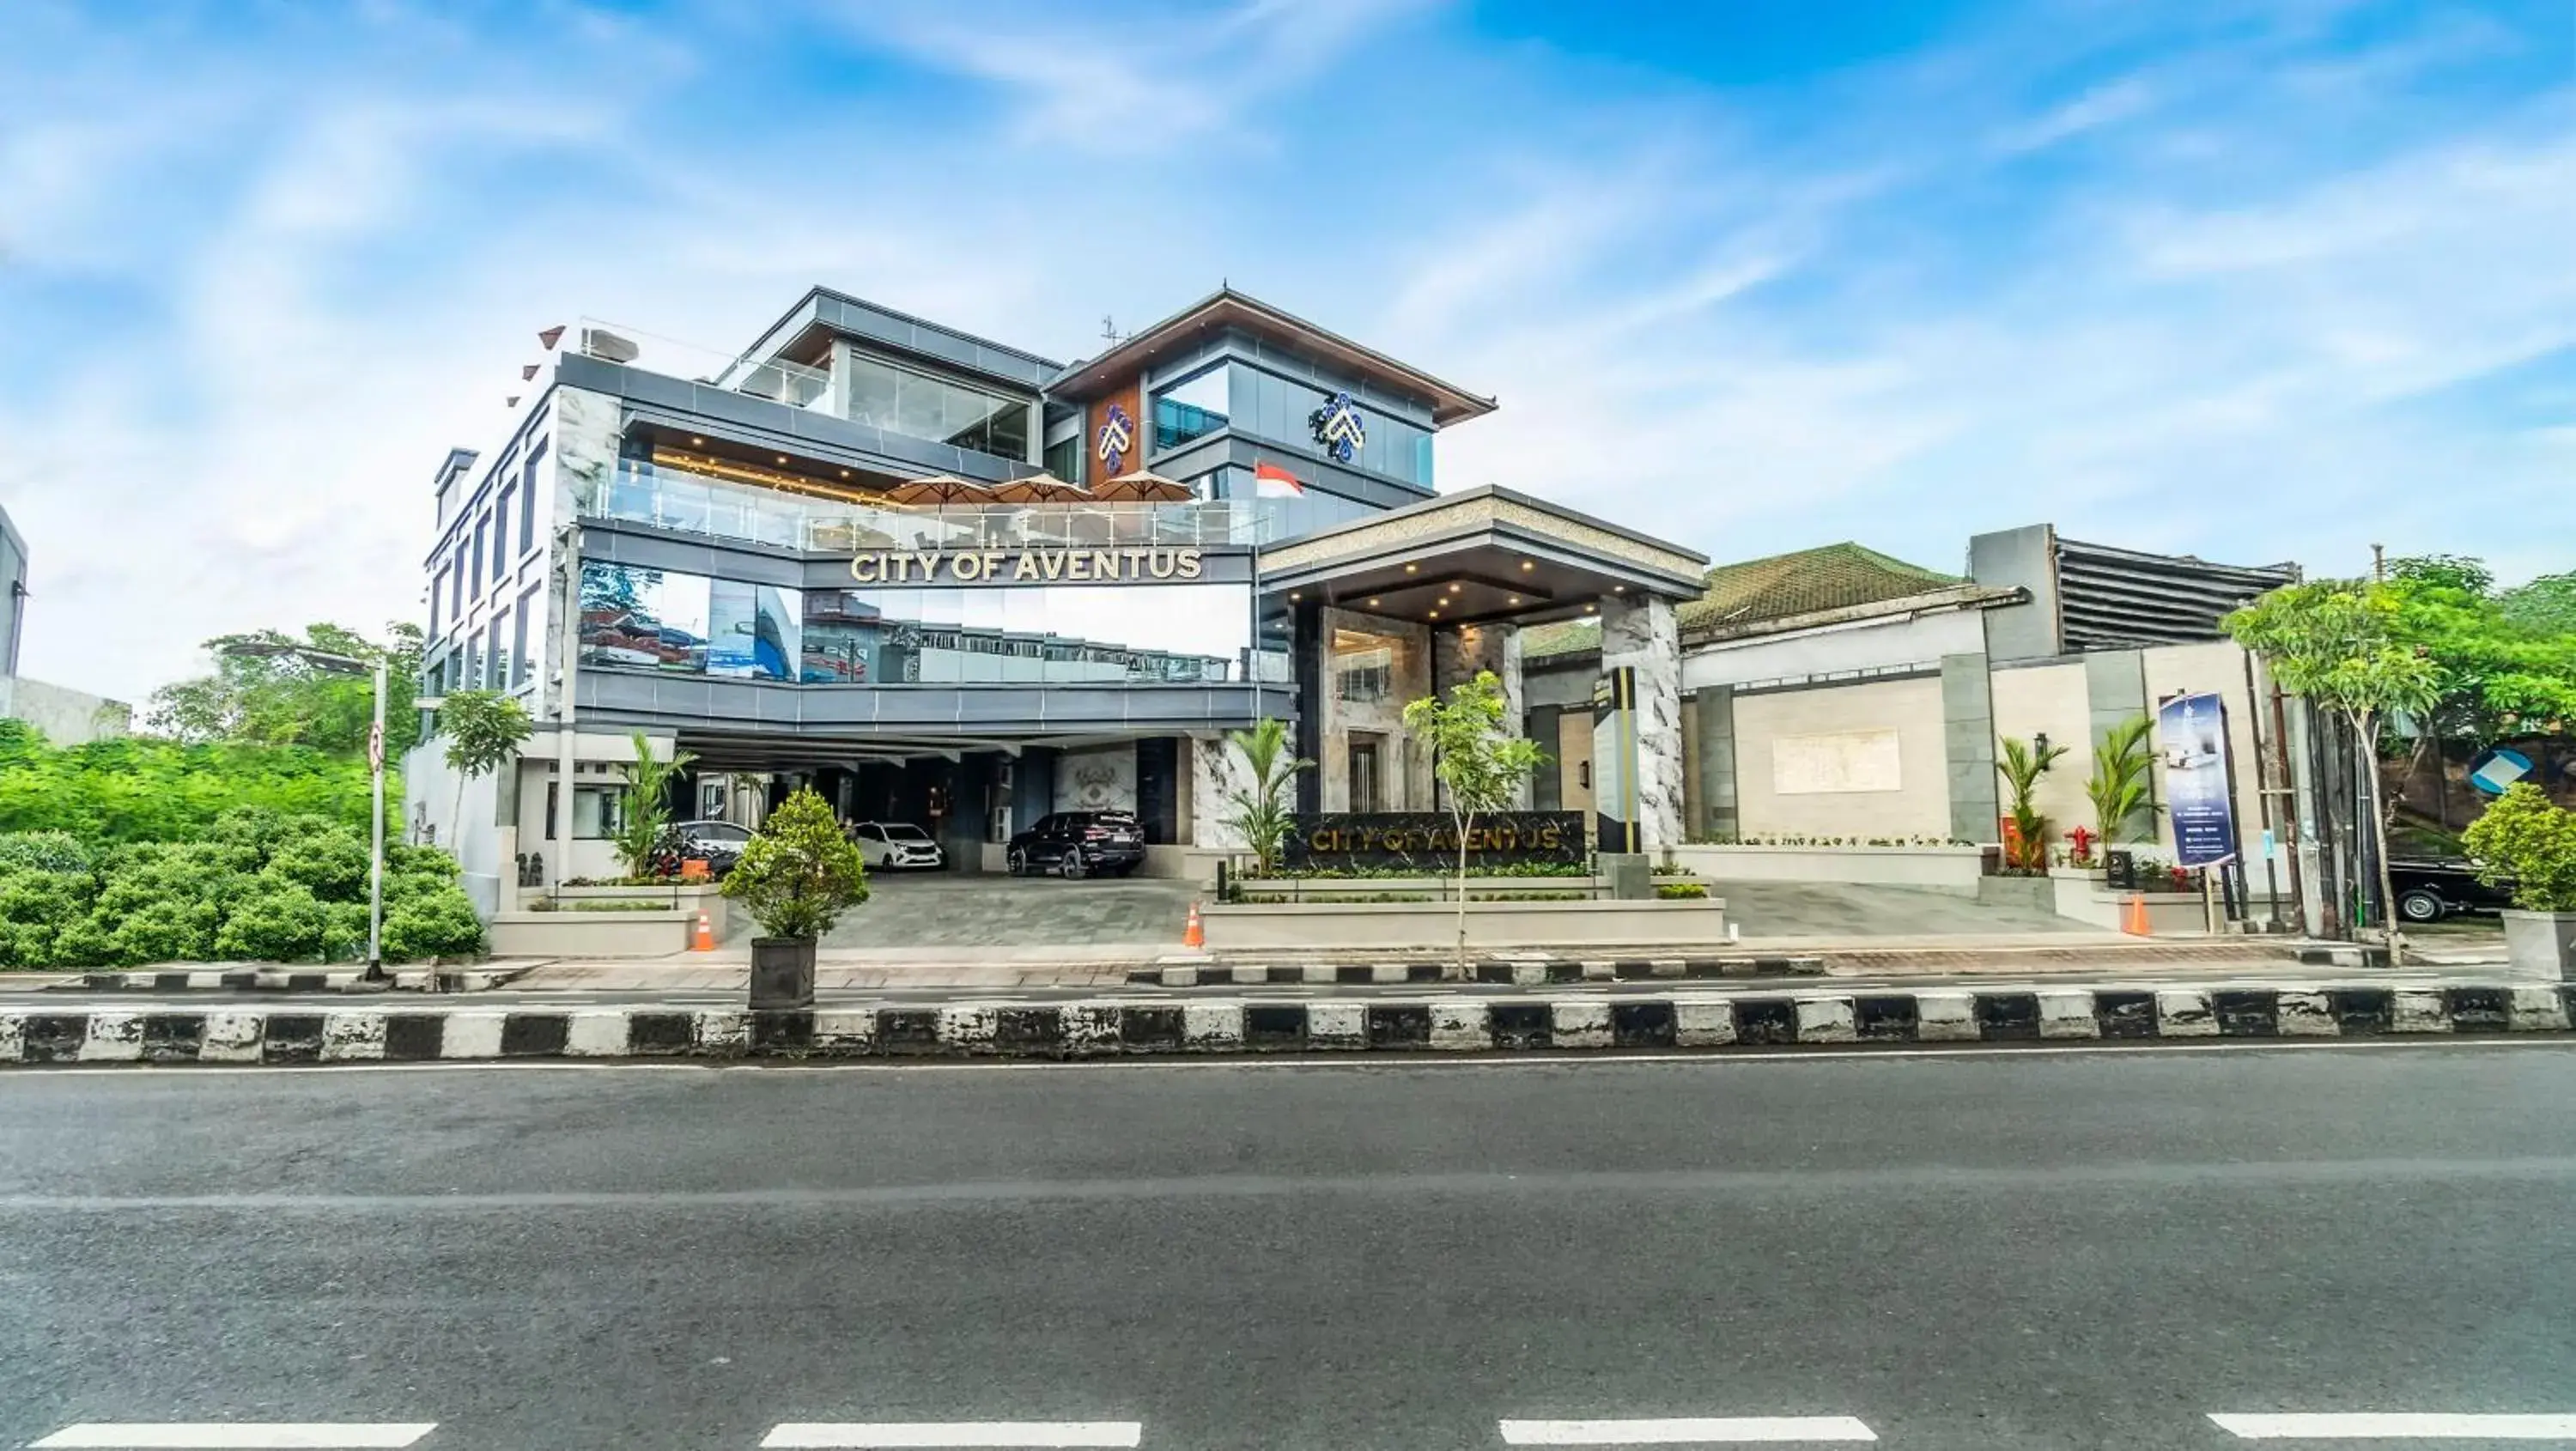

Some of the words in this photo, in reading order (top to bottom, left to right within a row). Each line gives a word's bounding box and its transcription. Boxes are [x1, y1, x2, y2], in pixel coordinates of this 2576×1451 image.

[851, 552, 940, 581] CITY
[951, 552, 1005, 581] OF
[1013, 549, 1202, 580] AVENTUS
[1311, 829, 1376, 851] CITY
[1382, 829, 1422, 851] OF
